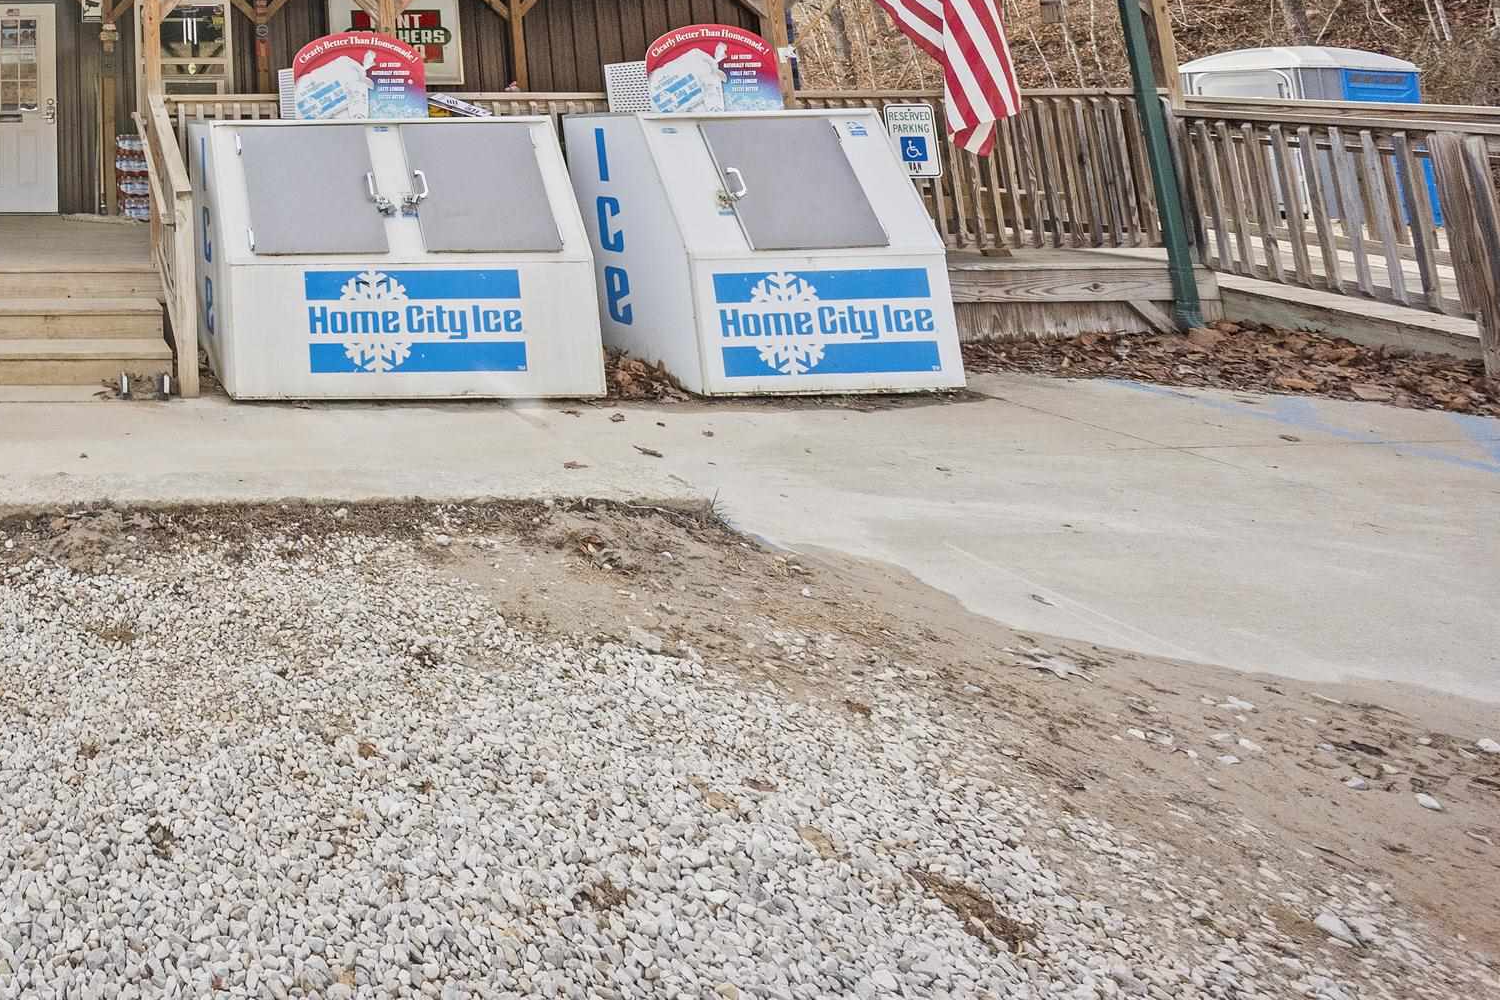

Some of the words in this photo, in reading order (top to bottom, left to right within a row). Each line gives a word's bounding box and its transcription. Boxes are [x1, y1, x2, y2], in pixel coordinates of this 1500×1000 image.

[299, 44, 324, 64] Clearly
[323, 39, 348, 49] Better
[348, 36, 370, 45] Than
[651, 37, 675, 57] Clearly
[675, 30, 700, 41] Better
[700, 28, 720, 37] Than
[888, 111, 931, 121] RESERVED
[892, 123, 930, 134] PARKING
[308, 306, 400, 334] Home
[405, 304, 468, 339] City
[471, 304, 523, 333] Ice
[719, 308, 814, 337] Home
[817, 305, 880, 340] City
[882, 304, 935, 333] Ice
